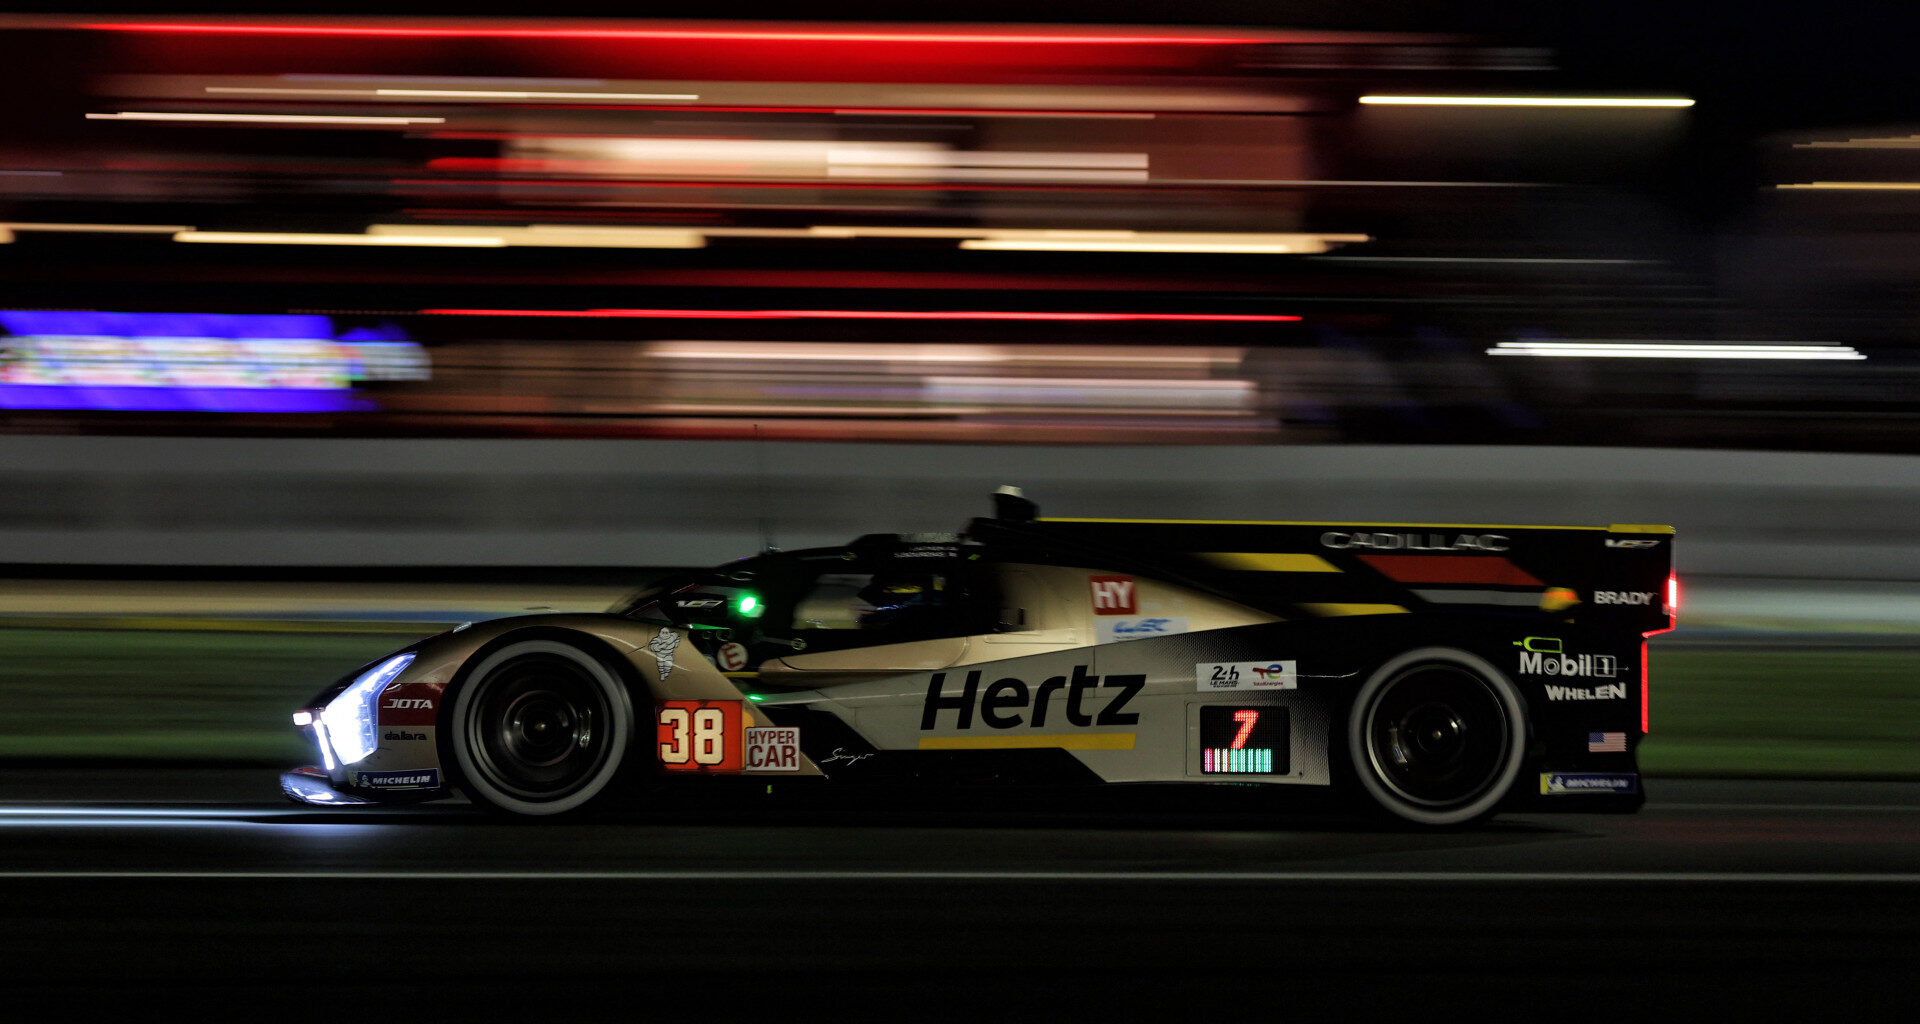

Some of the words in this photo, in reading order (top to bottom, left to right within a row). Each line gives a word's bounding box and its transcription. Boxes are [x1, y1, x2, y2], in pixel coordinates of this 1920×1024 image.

[1320, 531, 1511, 551] CADILLAC
[1091, 581, 1133, 609] HY
[1594, 590, 1654, 605] BRADY
[1519, 651, 1592, 677] Mobil
[383, 698, 433, 709] JOTA
[920, 665, 1147, 731] Hertz
[659, 708, 725, 765] 38
[749, 730, 795, 744] HYPER
[1231, 709, 1260, 750] 7
[749, 745, 796, 767] CAR
[371, 775, 431, 785] MICHELIN
